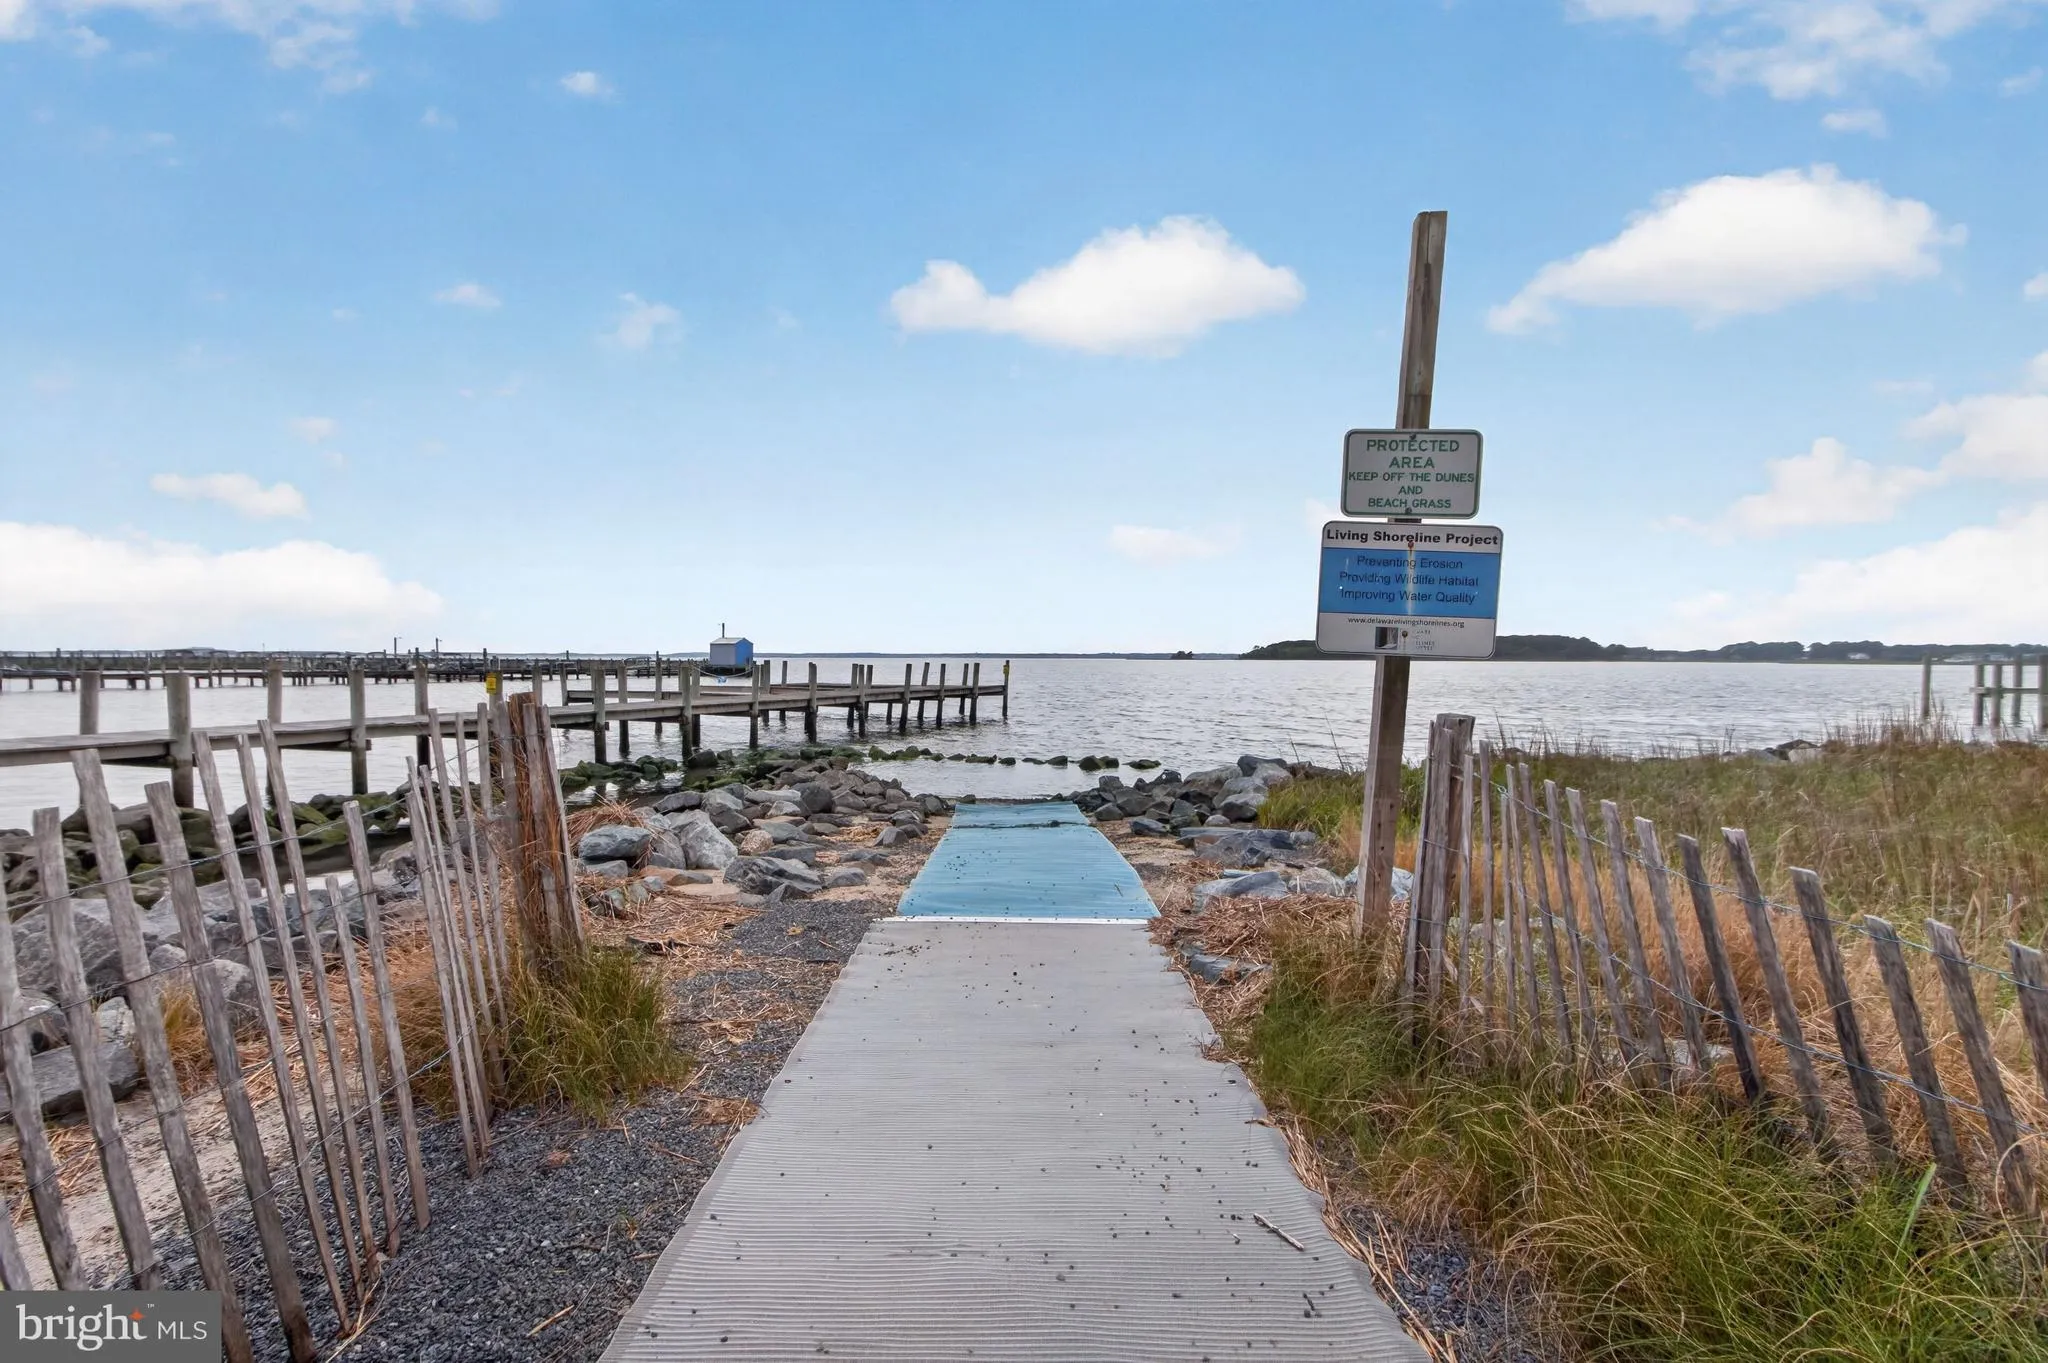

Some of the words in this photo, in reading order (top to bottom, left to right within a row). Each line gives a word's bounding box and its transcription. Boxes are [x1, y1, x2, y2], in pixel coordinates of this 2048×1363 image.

[1366, 439, 1460, 453] PROTECTED
[1388, 456, 1435, 469] AREA
[1348, 471, 1379, 481] KEEP
[1382, 472, 1406, 482] OFF
[1409, 472, 1431, 482] THE
[1435, 473, 1475, 483] DUNES
[1398, 485, 1423, 495] AND
[1368, 497, 1407, 508] BEACH
[1411, 498, 1451, 509] GRASS
[1327, 529, 1369, 543] Living
[1373, 531, 1441, 543] Shoreline
[1446, 533, 1498, 547] Project
[1356, 555, 1416, 569] Preventing
[1420, 557, 1463, 569] Erosion
[1339, 571, 1391, 586] Providing
[1395, 573, 1435, 585] Wildlife
[1340, 588, 1396, 602] Improving
[1399, 590, 1432, 601] Water
[1435, 591, 1475, 605] Quality
